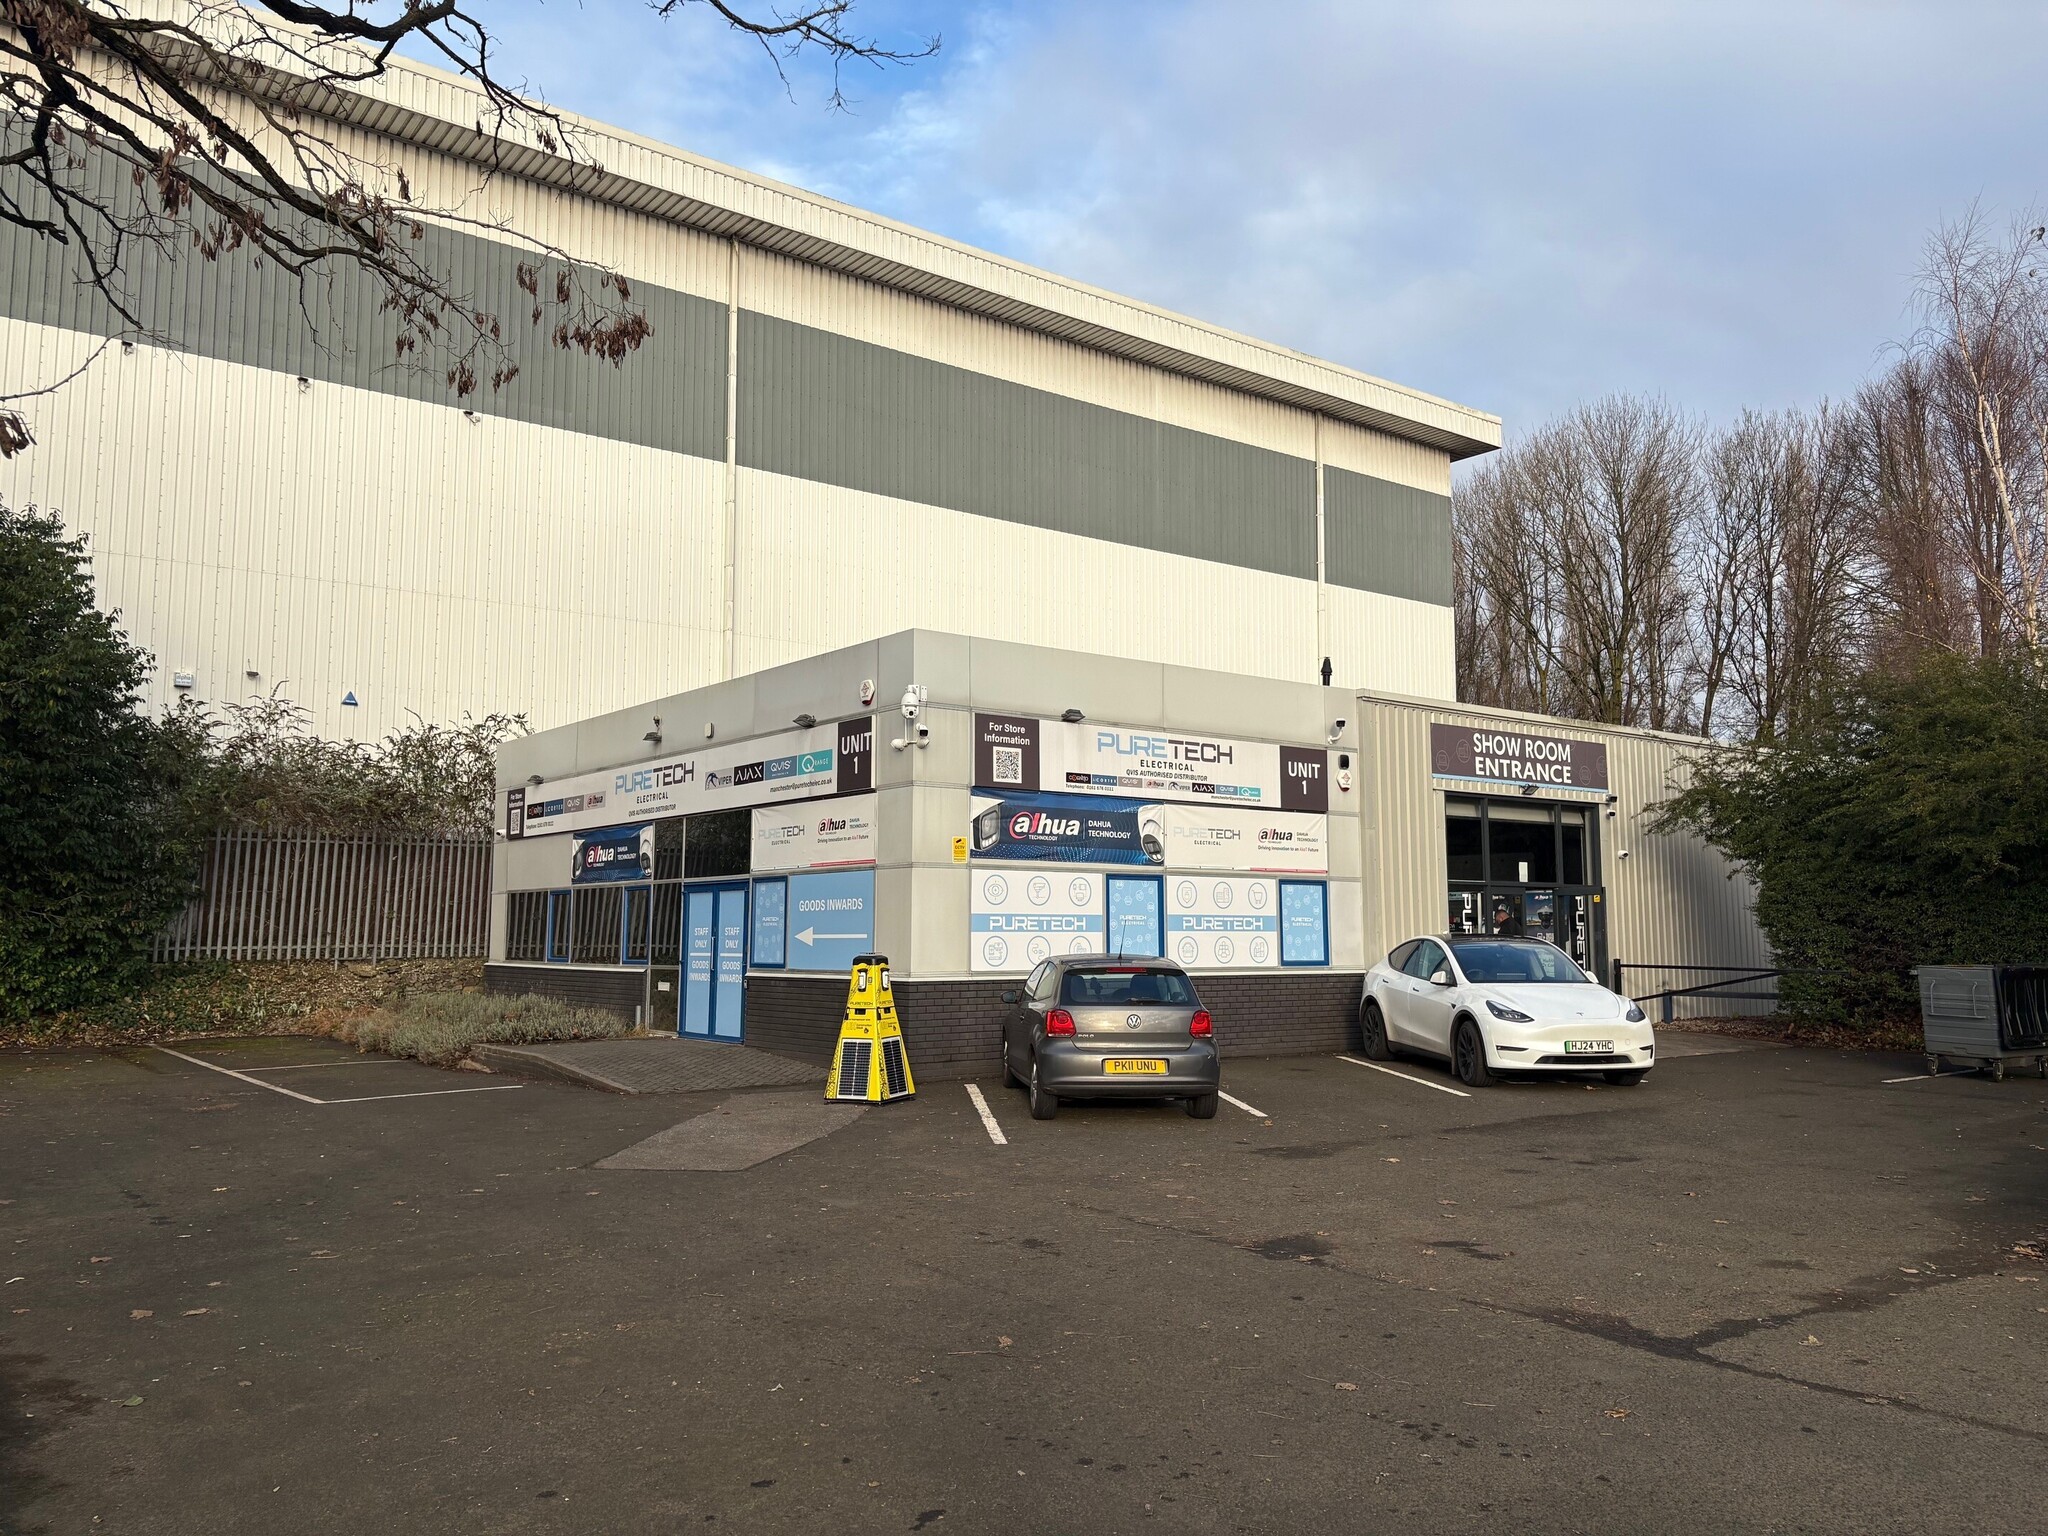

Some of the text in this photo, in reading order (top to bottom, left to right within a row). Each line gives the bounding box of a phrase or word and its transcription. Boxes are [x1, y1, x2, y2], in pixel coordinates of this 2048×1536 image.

[988, 722, 1025, 734] For Store
[841, 732, 872, 756] UNIT
[984, 733, 1030, 746] Information
[1097, 732, 1232, 764] PURETECH
[1473, 732, 1571, 763] SHOW ROOM
[853, 756, 858, 774] 1
[1140, 760, 1194, 772] ELECTRICAL
[1288, 761, 1320, 779] UNIT
[1474, 756, 1572, 784] ENTRANCE
[615, 760, 694, 795] PURETECH
[735, 766, 763, 782] AJAX
[1140, 770, 1173, 779] AUTHORISED
[1174, 772, 1208, 782] DISTRIBUTOR
[718, 775, 732, 786] VIPER
[1193, 784, 1214, 792] AJAX
[1302, 780, 1307, 794] 1
[636, 792, 668, 804] ELECTRICAL
[1088, 820, 1112, 828] DAHUA
[758, 825, 805, 839] PURETECH
[1088, 830, 1132, 839] TECHNOLOGY
[1174, 826, 1241, 840] PURETECH
[798, 898, 863, 912] GOODS INWARDS
[990, 916, 1086, 930] PURETECH
[1182, 917, 1264, 930] PURETECH
[694, 928, 708, 936] STAFF
[724, 927, 740, 936] STAFF
[694, 940, 707, 948] ONLY
[725, 940, 738, 948] ONLY
[692, 960, 709, 969] GOODS
[722, 961, 740, 970] GOODS
[1572, 1041, 1612, 1050] HJ24 YHC
[1114, 1061, 1157, 1070] PK11 UNU
